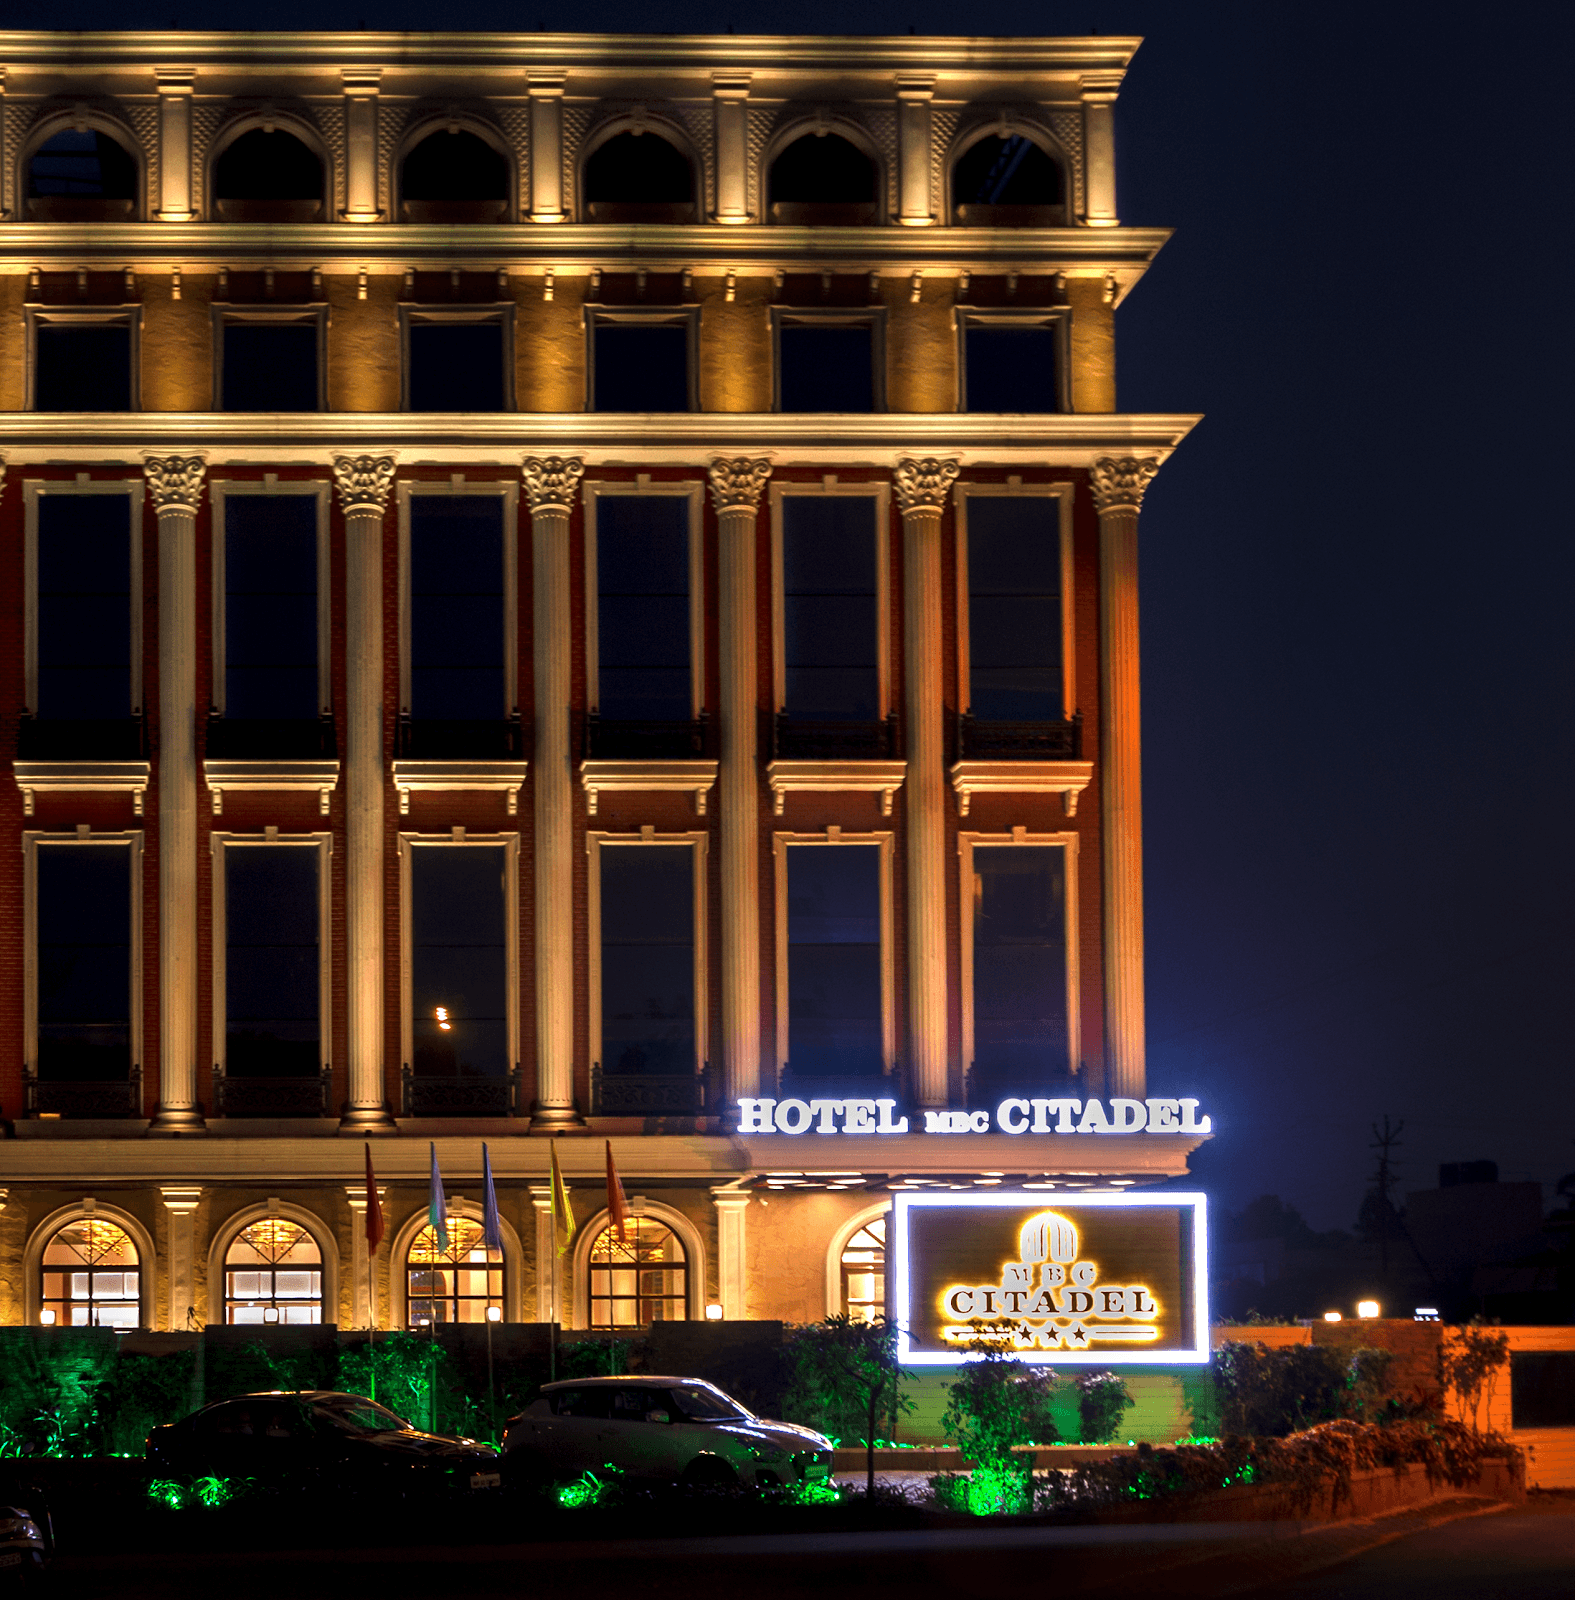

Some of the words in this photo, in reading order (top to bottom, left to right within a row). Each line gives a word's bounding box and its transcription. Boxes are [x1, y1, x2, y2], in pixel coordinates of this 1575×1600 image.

[737, 1098, 909, 1135] HOTEL
[924, 1111, 990, 1134] MBC
[996, 1098, 1212, 1135] CITADEL
[950, 1290, 1155, 1314] CITADEL
